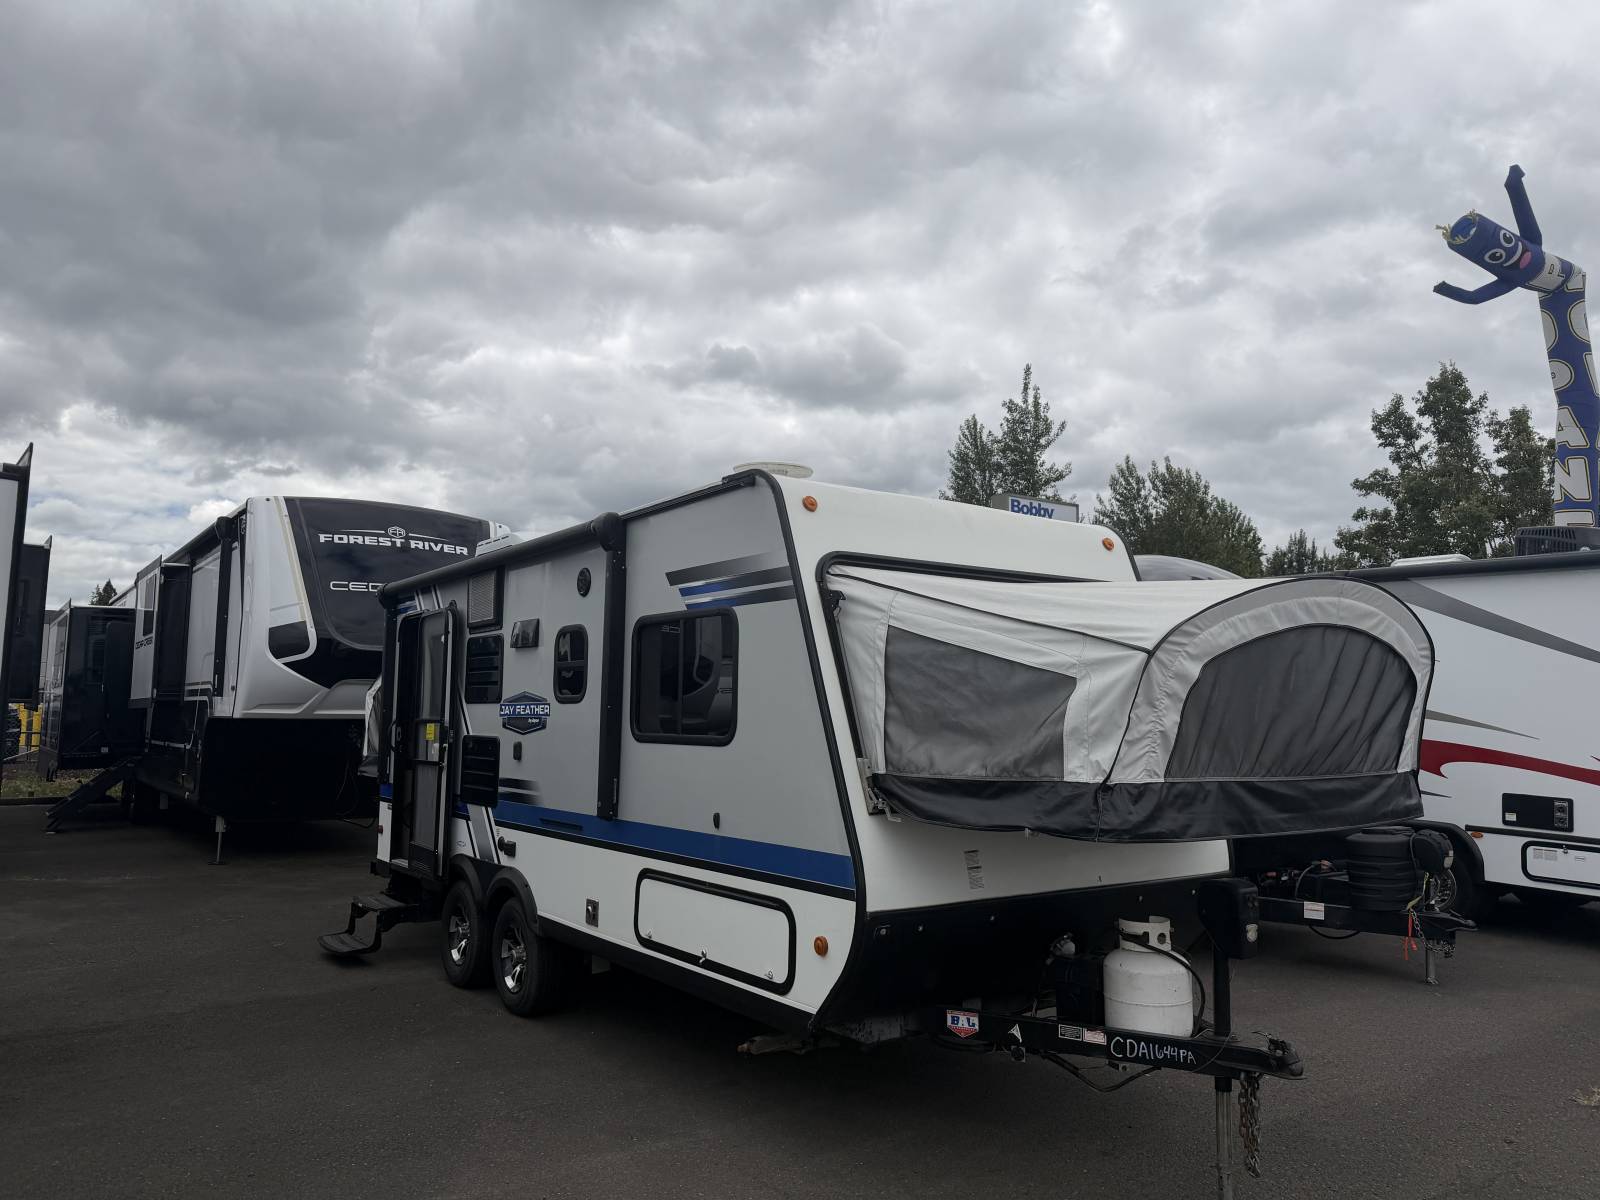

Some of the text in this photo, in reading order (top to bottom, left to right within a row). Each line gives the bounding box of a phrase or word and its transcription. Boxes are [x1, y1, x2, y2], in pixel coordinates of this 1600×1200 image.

[1010, 498, 1055, 519] Bobby
[318, 533, 469, 556] FOREST RIVER
[500, 704, 550, 715] JAY FEATHER
[1110, 1036, 1197, 1065] CDA1644PA
